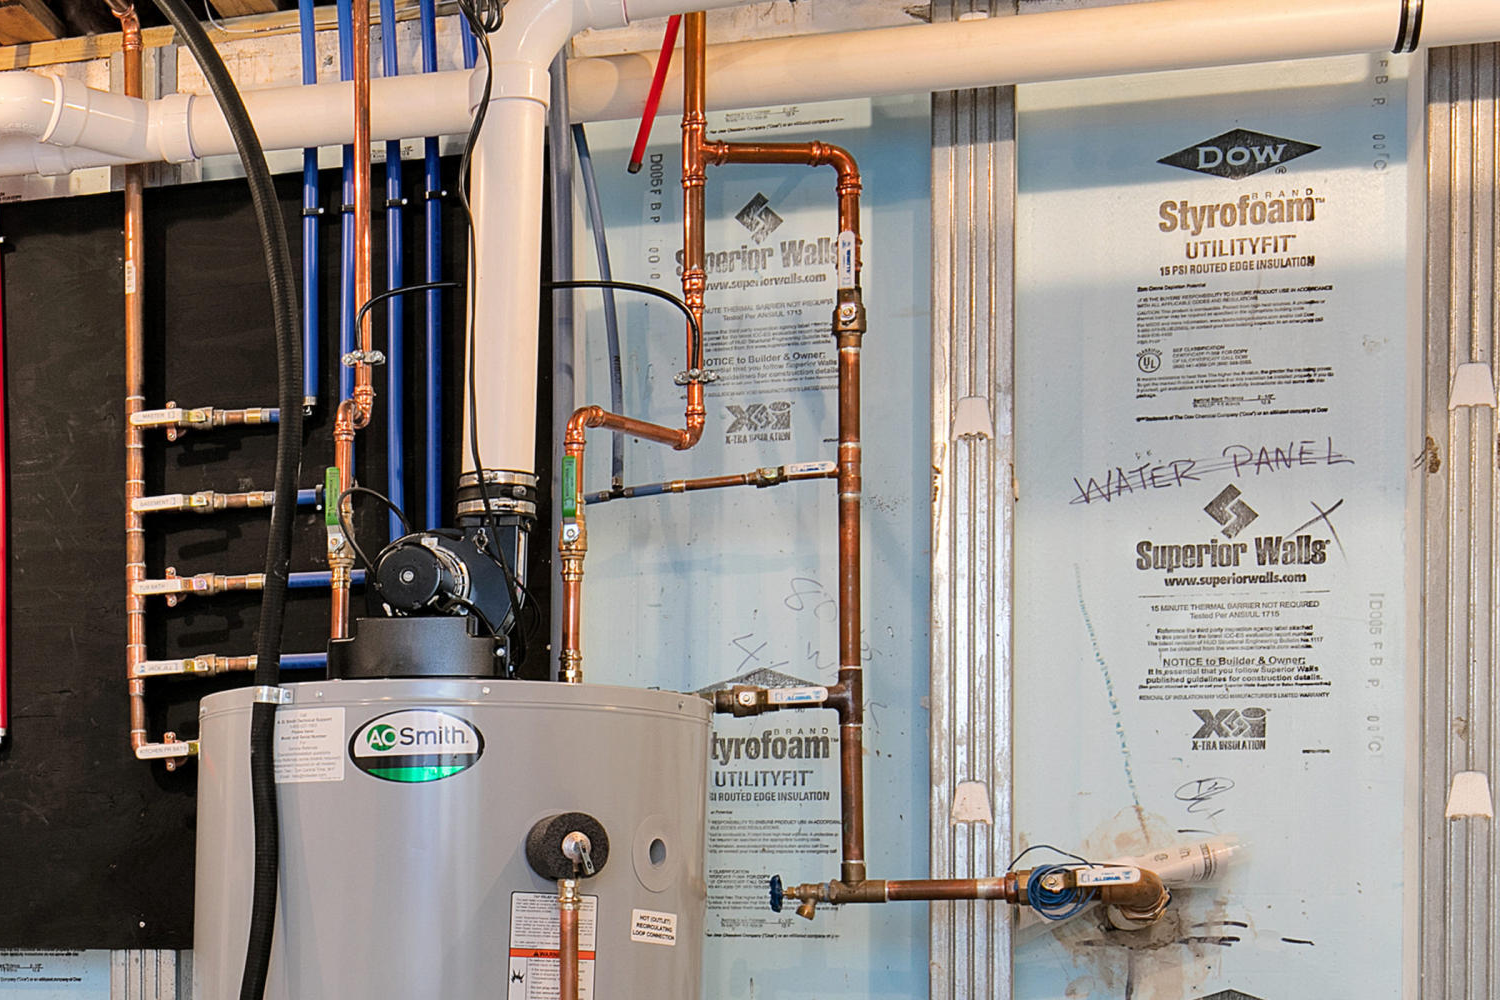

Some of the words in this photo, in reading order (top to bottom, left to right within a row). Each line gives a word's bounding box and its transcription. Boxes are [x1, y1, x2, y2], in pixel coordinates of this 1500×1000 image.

[1196, 143, 1288, 170] DOW
[1251, 188, 1314, 199] BRAND
[1159, 266, 1171, 276] 15
[1172, 265, 1188, 276] PSI
[1189, 262, 1228, 275] ROUTED
[1229, 260, 1255, 273] EDGE
[1256, 255, 1316, 271] INSULATION
[1069, 459, 1201, 505] WATER
[1221, 436, 1354, 478] PANEL
[1135, 537, 1248, 573] Superior
[1253, 534, 1328, 567] Walls
[1163, 571, 1307, 588] www.superiorwalls.com
[1262, 601, 1278, 609] NOT
[1279, 600, 1320, 608] REQUIRED
[1162, 657, 1203, 668] NOTICE
[1205, 657, 1217, 667] to
[1218, 656, 1256, 667] Builder
[1257, 656, 1266, 666] &
[773, 727, 829, 736] BRAND
[710, 730, 831, 766] tyrofoam
[718, 792, 752, 802] ROUTED
[753, 792, 776, 802] EDGE
[777, 790, 830, 802] INSULATION
